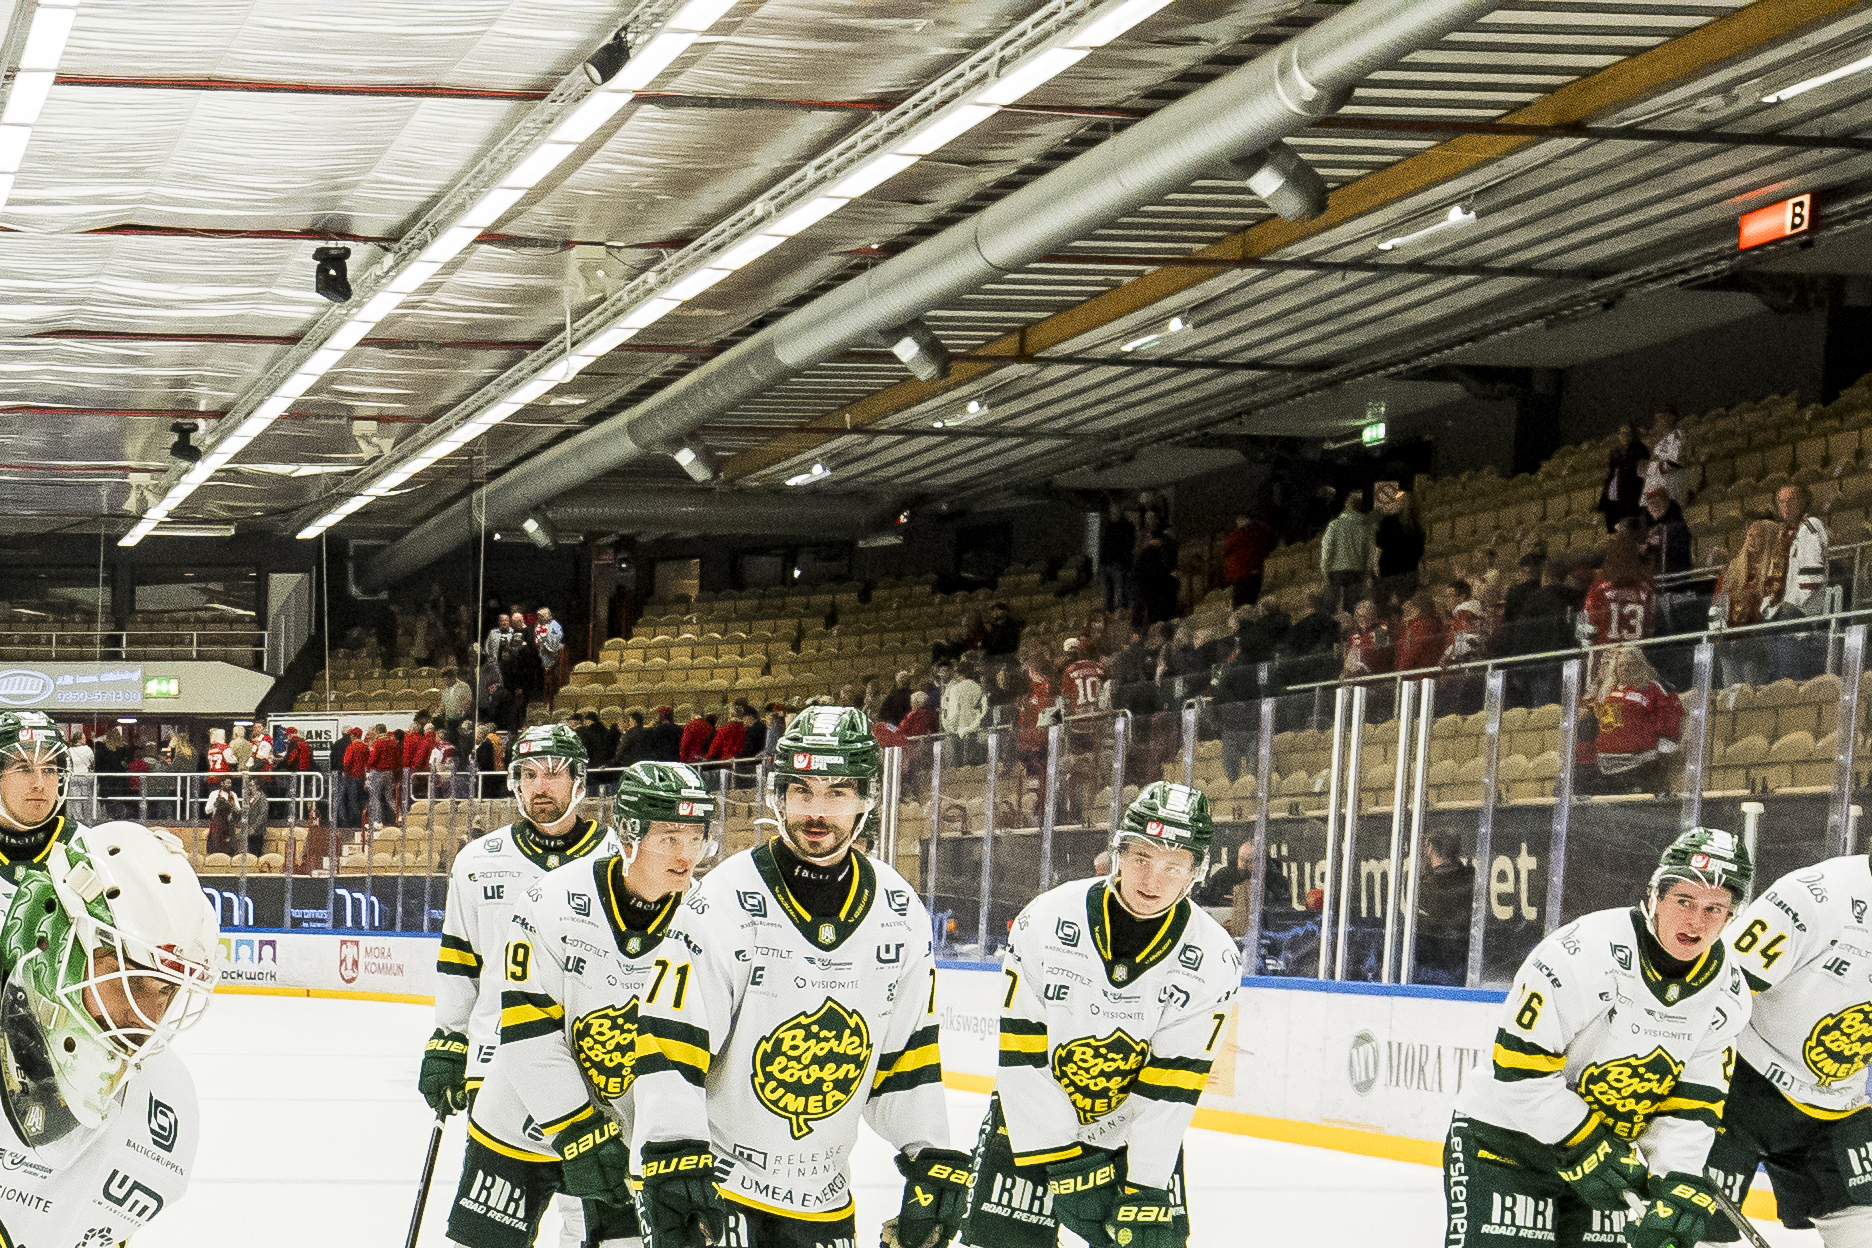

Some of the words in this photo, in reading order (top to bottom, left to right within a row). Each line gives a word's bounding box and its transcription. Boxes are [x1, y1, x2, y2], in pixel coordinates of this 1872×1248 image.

[1790, 200, 1805, 232] B
[483, 884, 504, 900] UE
[1796, 870, 1829, 904] Diös
[1765, 891, 1808, 933] Quicke
[1733, 918, 1789, 970] 64
[645, 958, 691, 1010] 71
[810, 978, 860, 990] VISIONITE
[1044, 983, 1070, 1001] UE
[1643, 1026, 1693, 1042] VISIONITE
[763, 1081, 847, 1113] UMEÅ
[125, 1138, 185, 1176] BALTICGRUPPEN
[459, 1197, 485, 1215] ROAD
[981, 1202, 1011, 1217] ROAD
[1013, 1211, 1056, 1228] RENTAL
[1481, 1222, 1516, 1236] ROAD
[1583, 1231, 1616, 1242] ROAD
